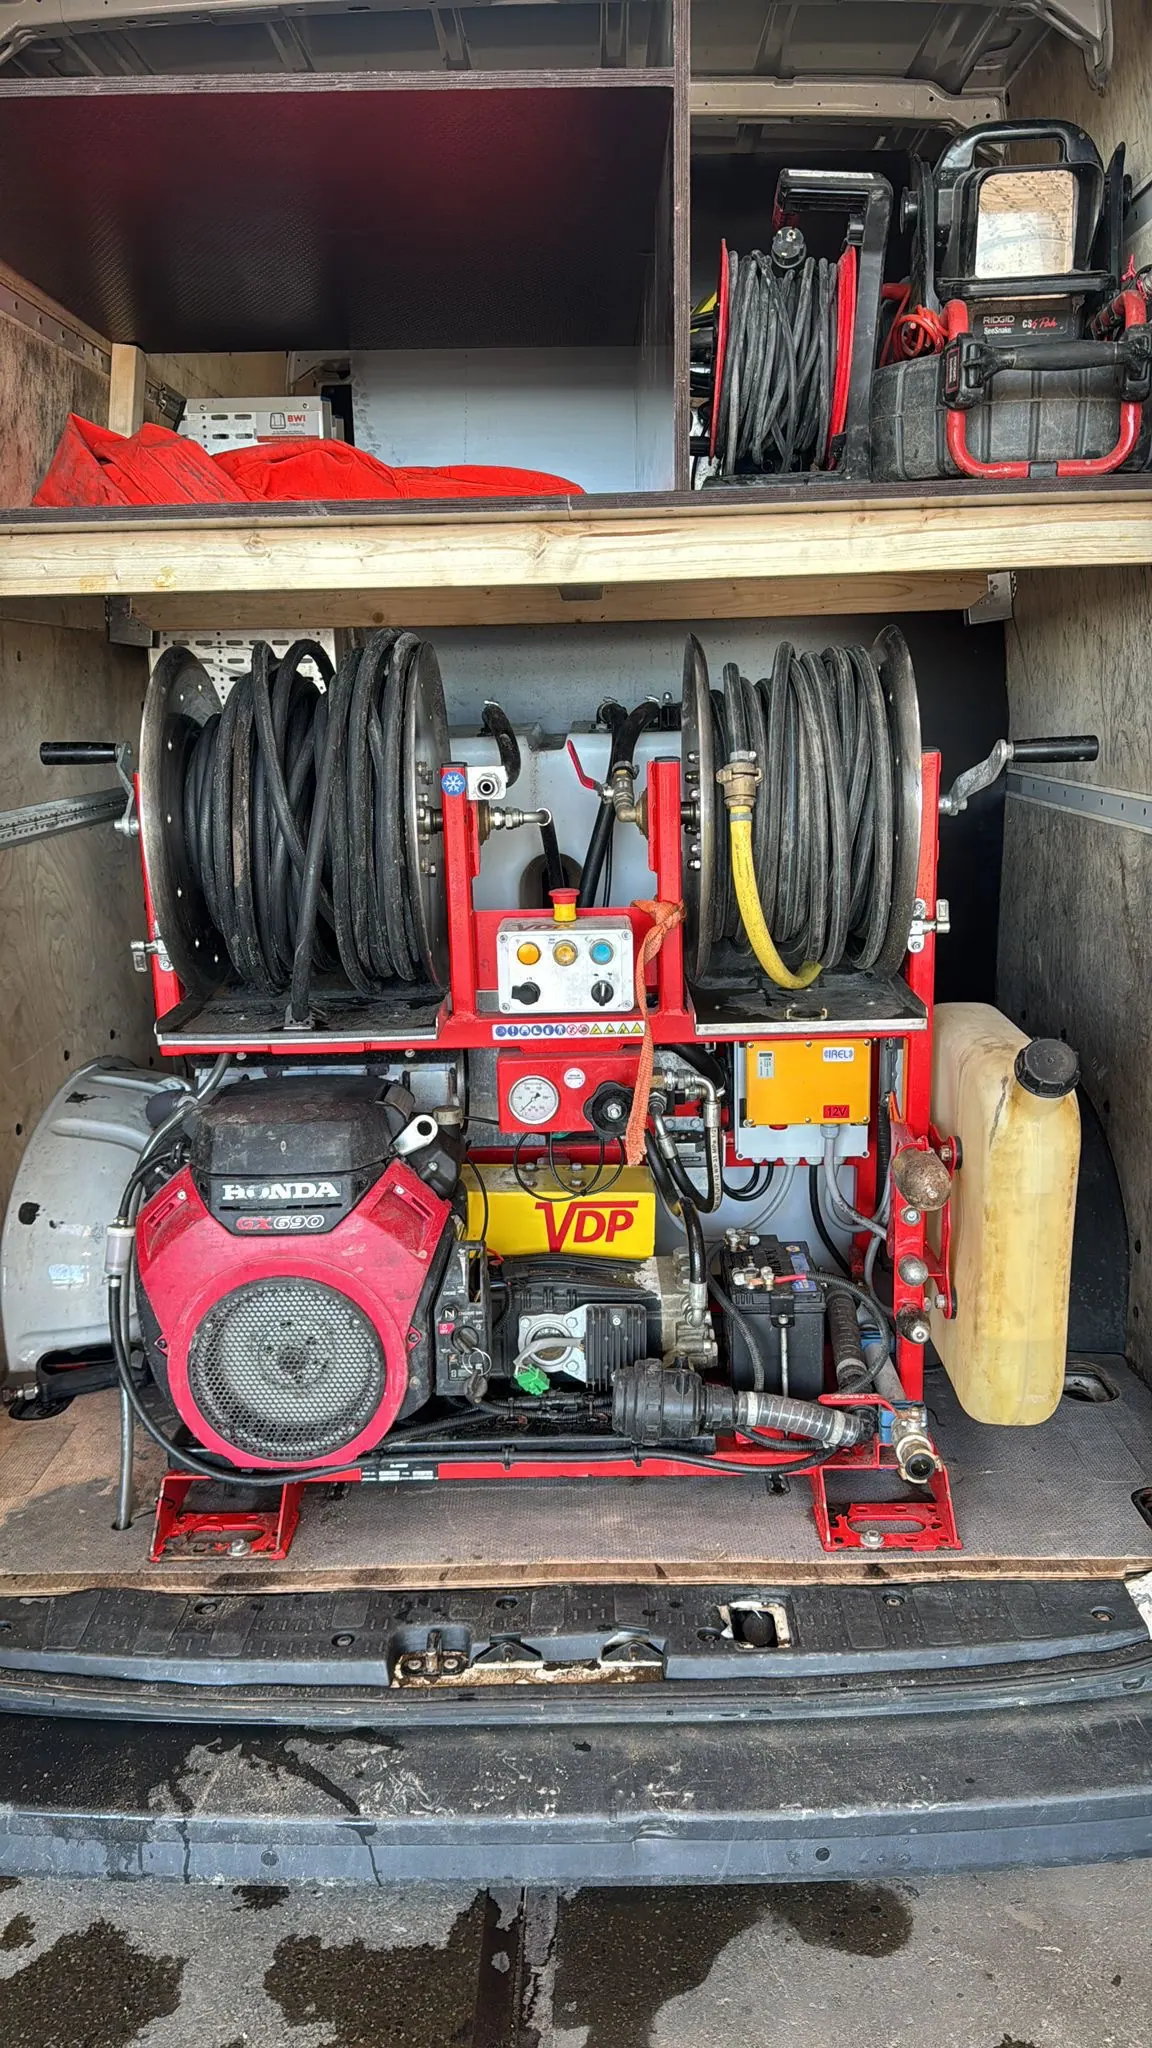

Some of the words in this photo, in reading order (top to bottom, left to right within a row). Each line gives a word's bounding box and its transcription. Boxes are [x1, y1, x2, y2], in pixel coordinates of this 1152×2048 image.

[983, 315, 1015, 324] RIDGID
[287, 414, 306, 422] BWI
[826, 1106, 847, 1117] 12V
[222, 1182, 340, 1200] HONDA
[235, 1214, 325, 1231] GX690
[535, 1200, 639, 1253] VDP
